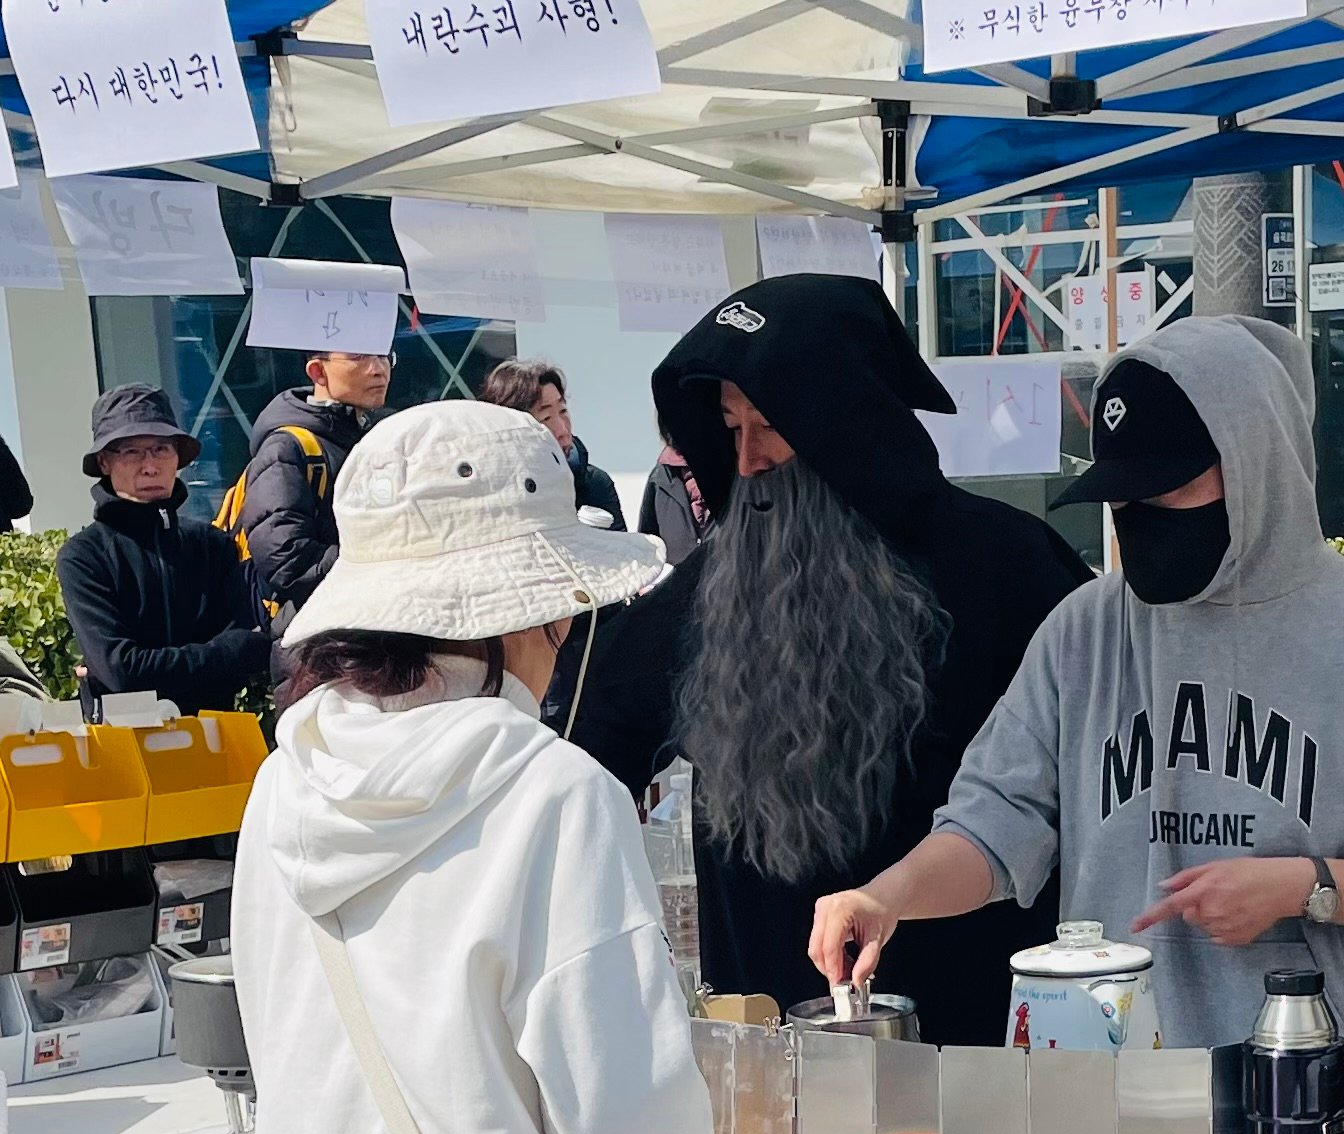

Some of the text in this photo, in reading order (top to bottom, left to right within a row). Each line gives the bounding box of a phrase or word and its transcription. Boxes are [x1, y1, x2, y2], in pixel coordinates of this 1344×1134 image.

[402, 0, 522, 56] 내란수괴
[977, 2, 1048, 40] 무식한
[51, 52, 223, 115] 다시 대한민국!
